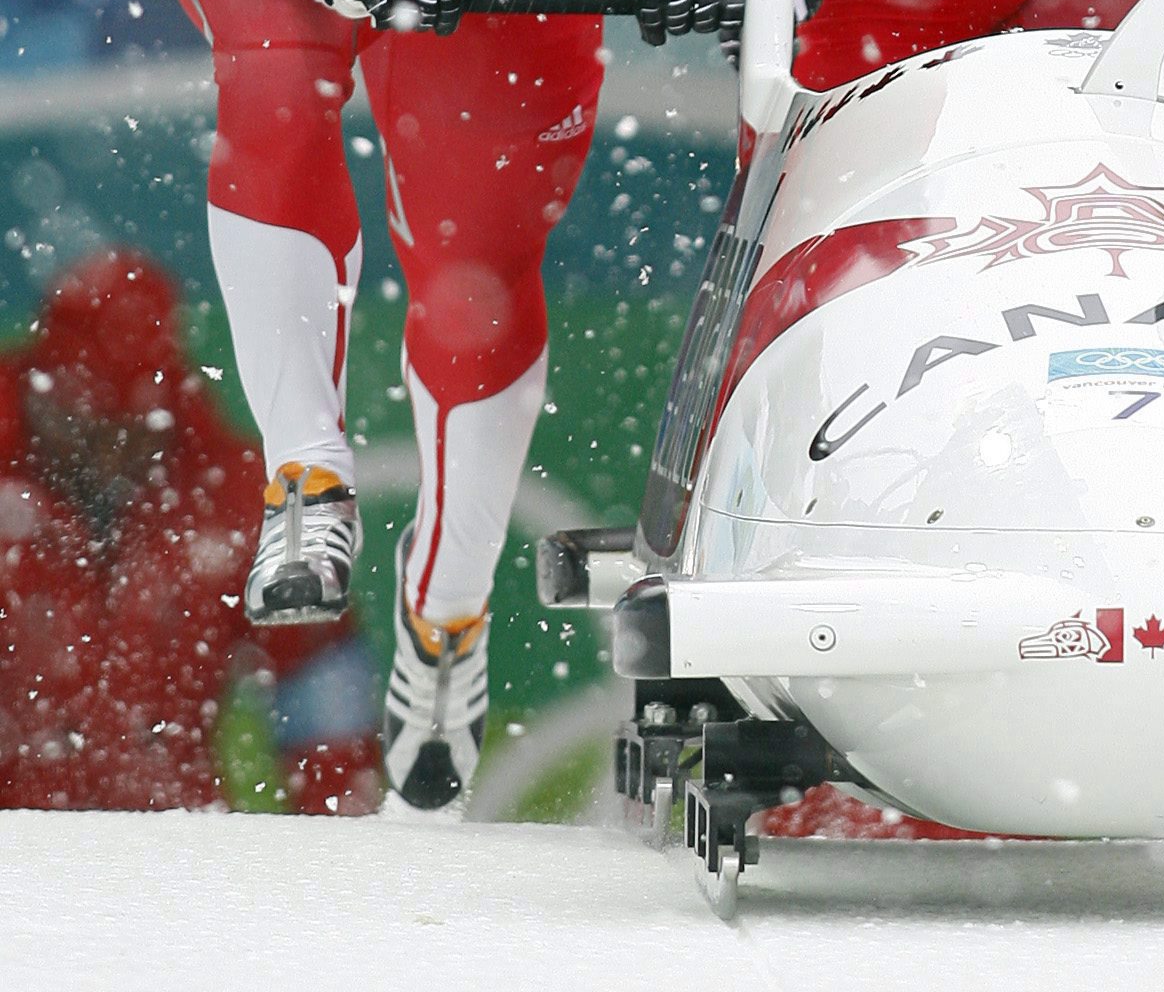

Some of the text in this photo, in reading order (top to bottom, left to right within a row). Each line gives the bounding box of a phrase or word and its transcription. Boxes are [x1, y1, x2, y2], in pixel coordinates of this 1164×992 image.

[538, 121, 587, 141] adidas
[1062, 379, 1157, 390] vancouver
[1108, 390, 1162, 420] 7
